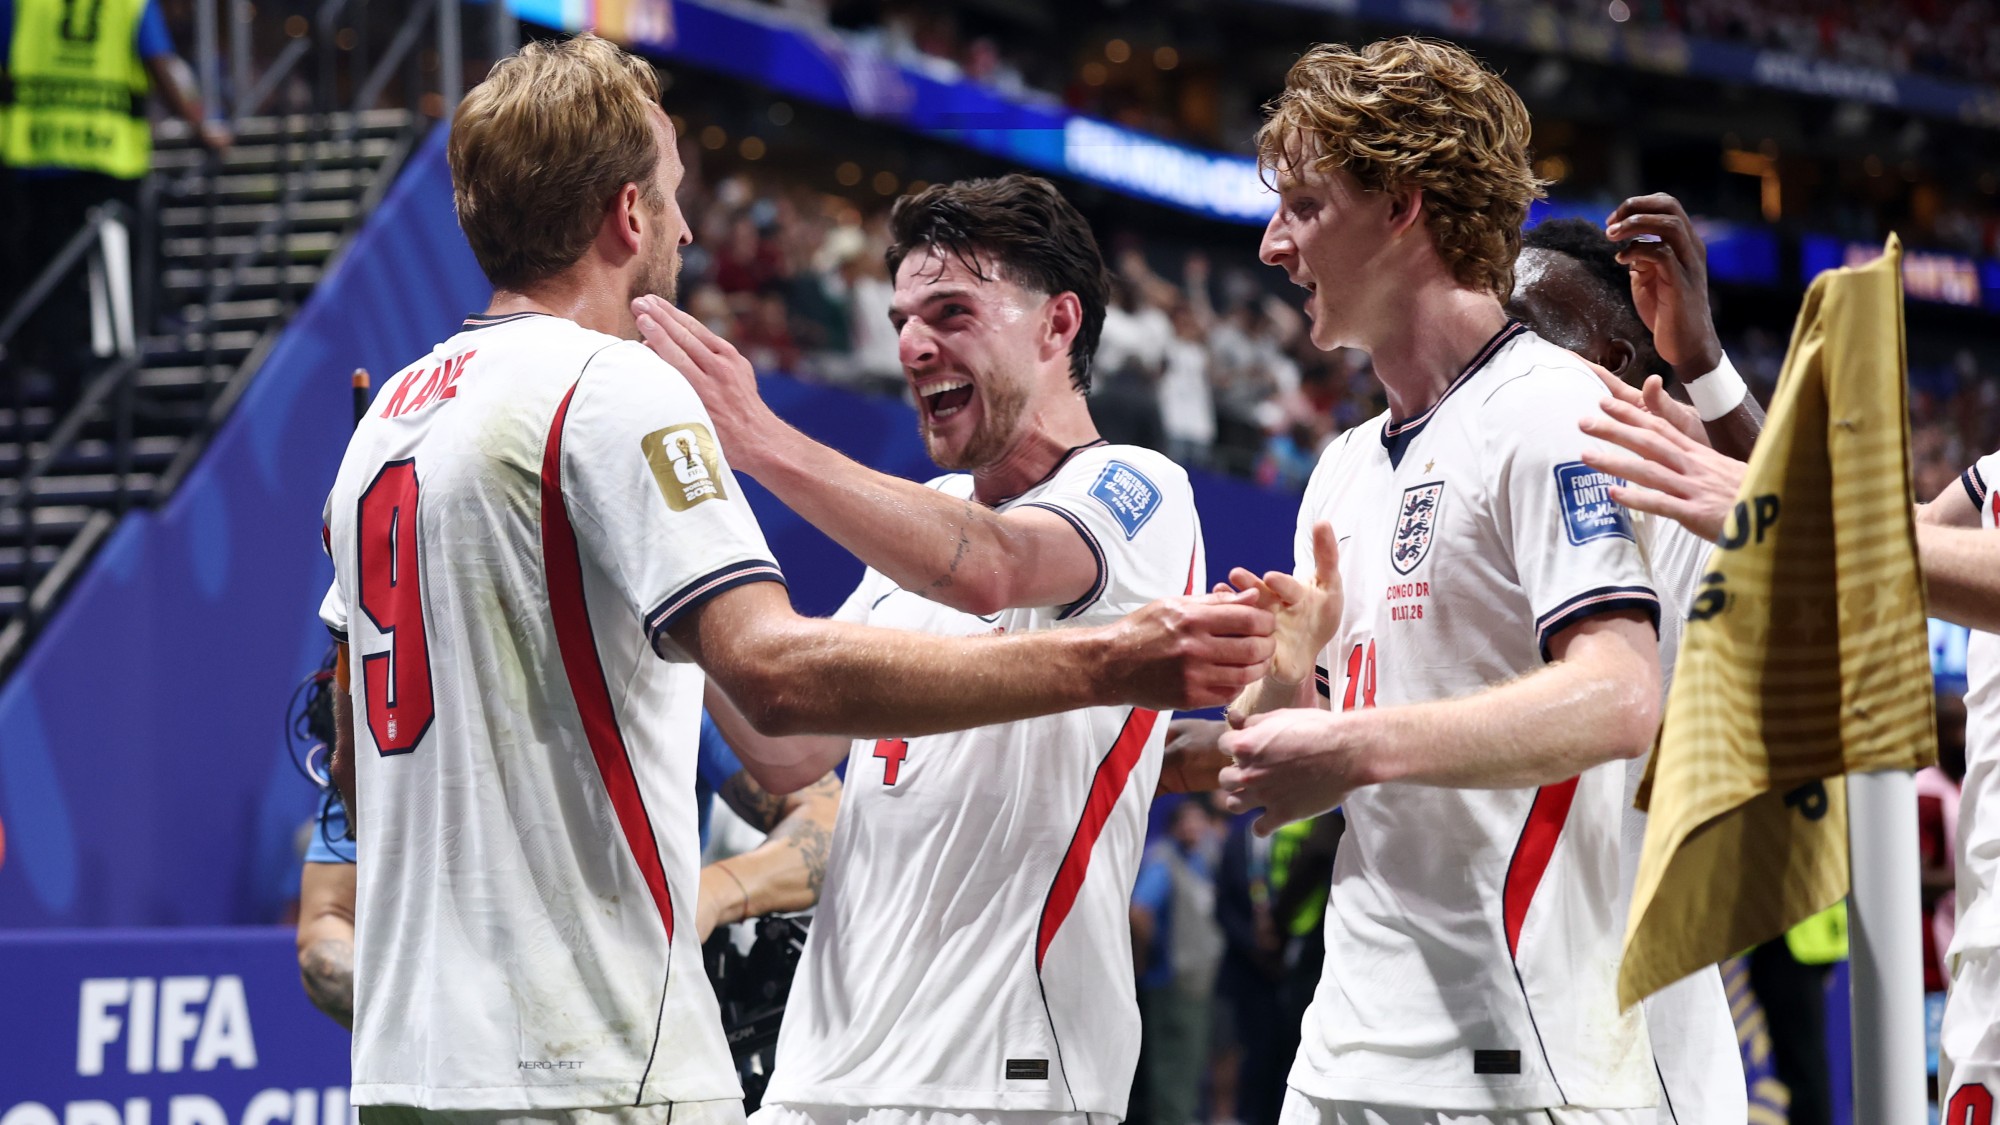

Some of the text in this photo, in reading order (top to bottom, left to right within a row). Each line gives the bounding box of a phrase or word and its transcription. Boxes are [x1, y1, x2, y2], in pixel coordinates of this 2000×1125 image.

[379, 349, 478, 419] KANE
[1113, 470, 1149, 510] UNITES
[1117, 467, 1152, 501] FOOTBALL
[1573, 484, 1609, 507] UNIT
[1593, 517, 1617, 527] FIFA
[1716, 493, 1780, 550] UP
[357, 456, 435, 758] 9
[1386, 582, 1430, 600] CONGO DR
[76, 975, 258, 1077] FIFA
[517, 1060, 585, 1070] AERO-FIT
